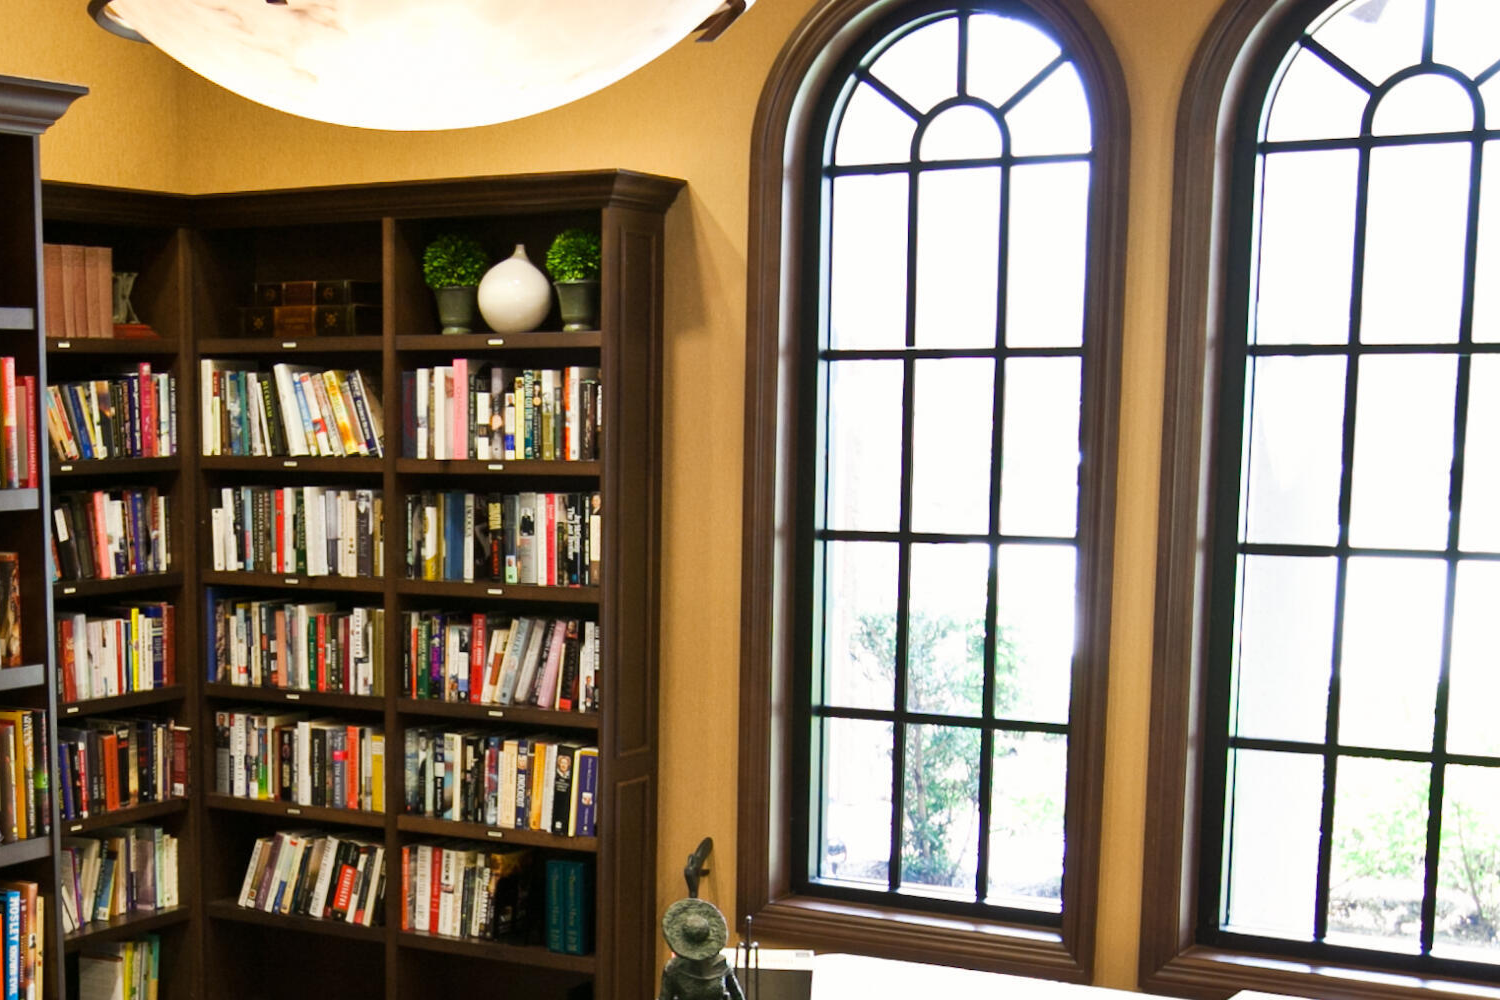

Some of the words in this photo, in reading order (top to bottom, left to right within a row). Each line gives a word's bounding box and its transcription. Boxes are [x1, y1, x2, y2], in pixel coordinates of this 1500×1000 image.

[488, 502, 502, 530] SINATRA
[515, 774, 526, 807] KNOCKOUT
[8, 896, 21, 942] MOSLEY
